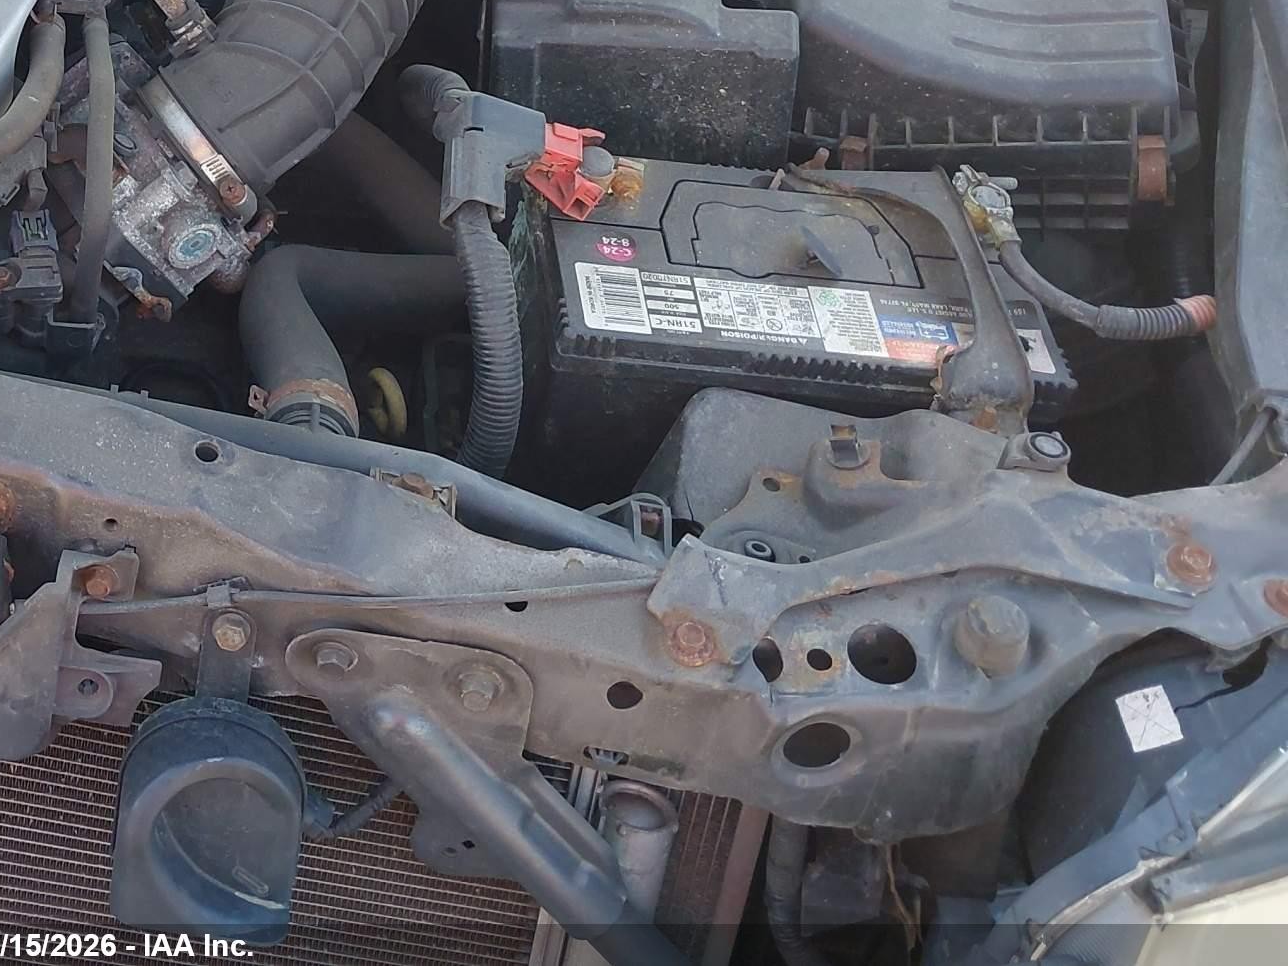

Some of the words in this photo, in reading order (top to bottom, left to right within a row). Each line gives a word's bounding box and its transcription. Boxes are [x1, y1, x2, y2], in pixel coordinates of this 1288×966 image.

[602, 245, 632, 257] C-24
[663, 289, 675, 297] 75
[655, 317, 697, 329] 51RN-C
